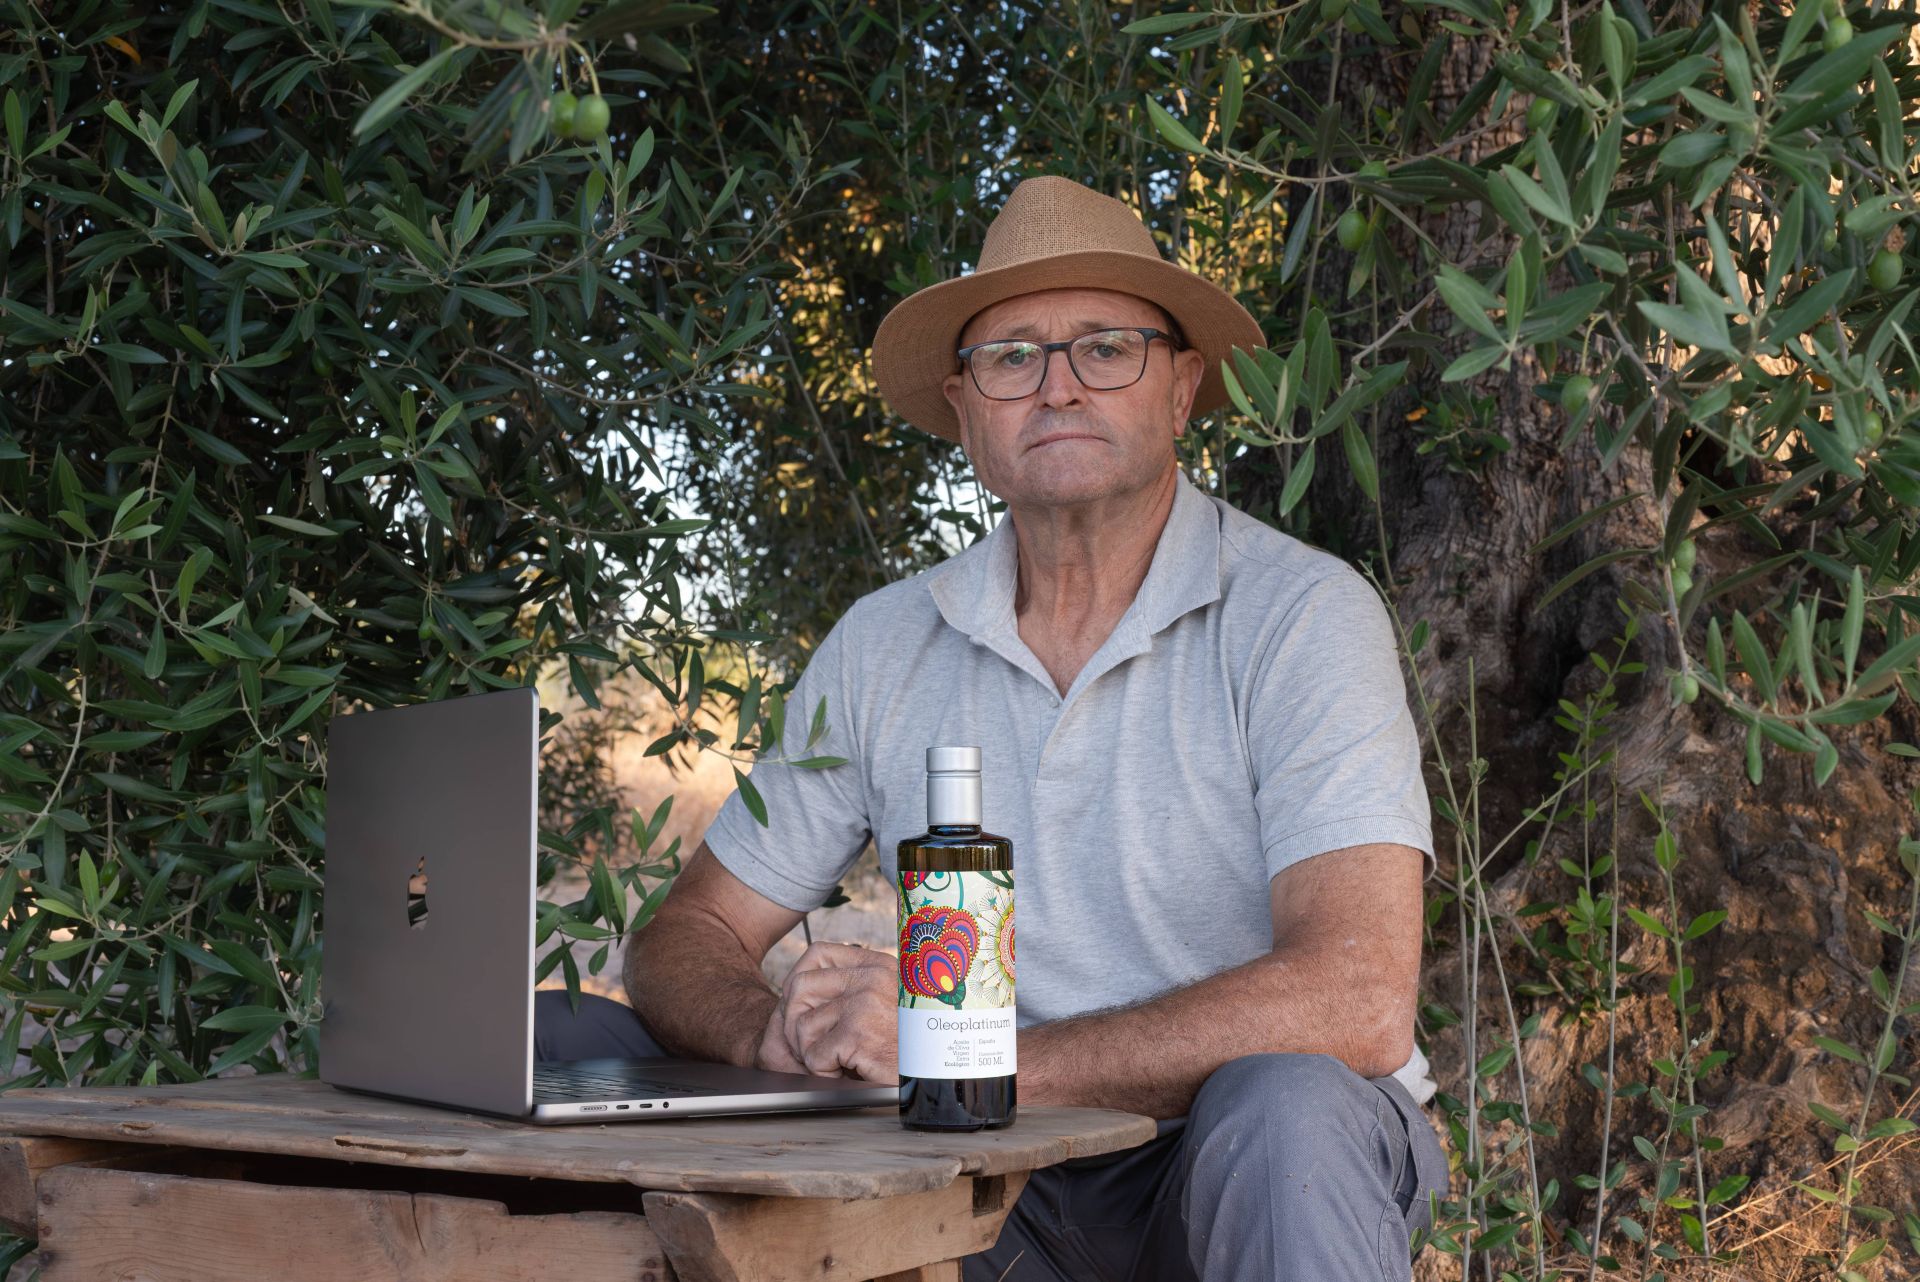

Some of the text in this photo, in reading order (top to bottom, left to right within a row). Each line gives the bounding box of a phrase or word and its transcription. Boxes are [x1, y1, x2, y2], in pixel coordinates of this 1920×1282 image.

[927, 1017, 1010, 1032] Oleoplatinum
[978, 1055, 1004, 1066] 500 ML
